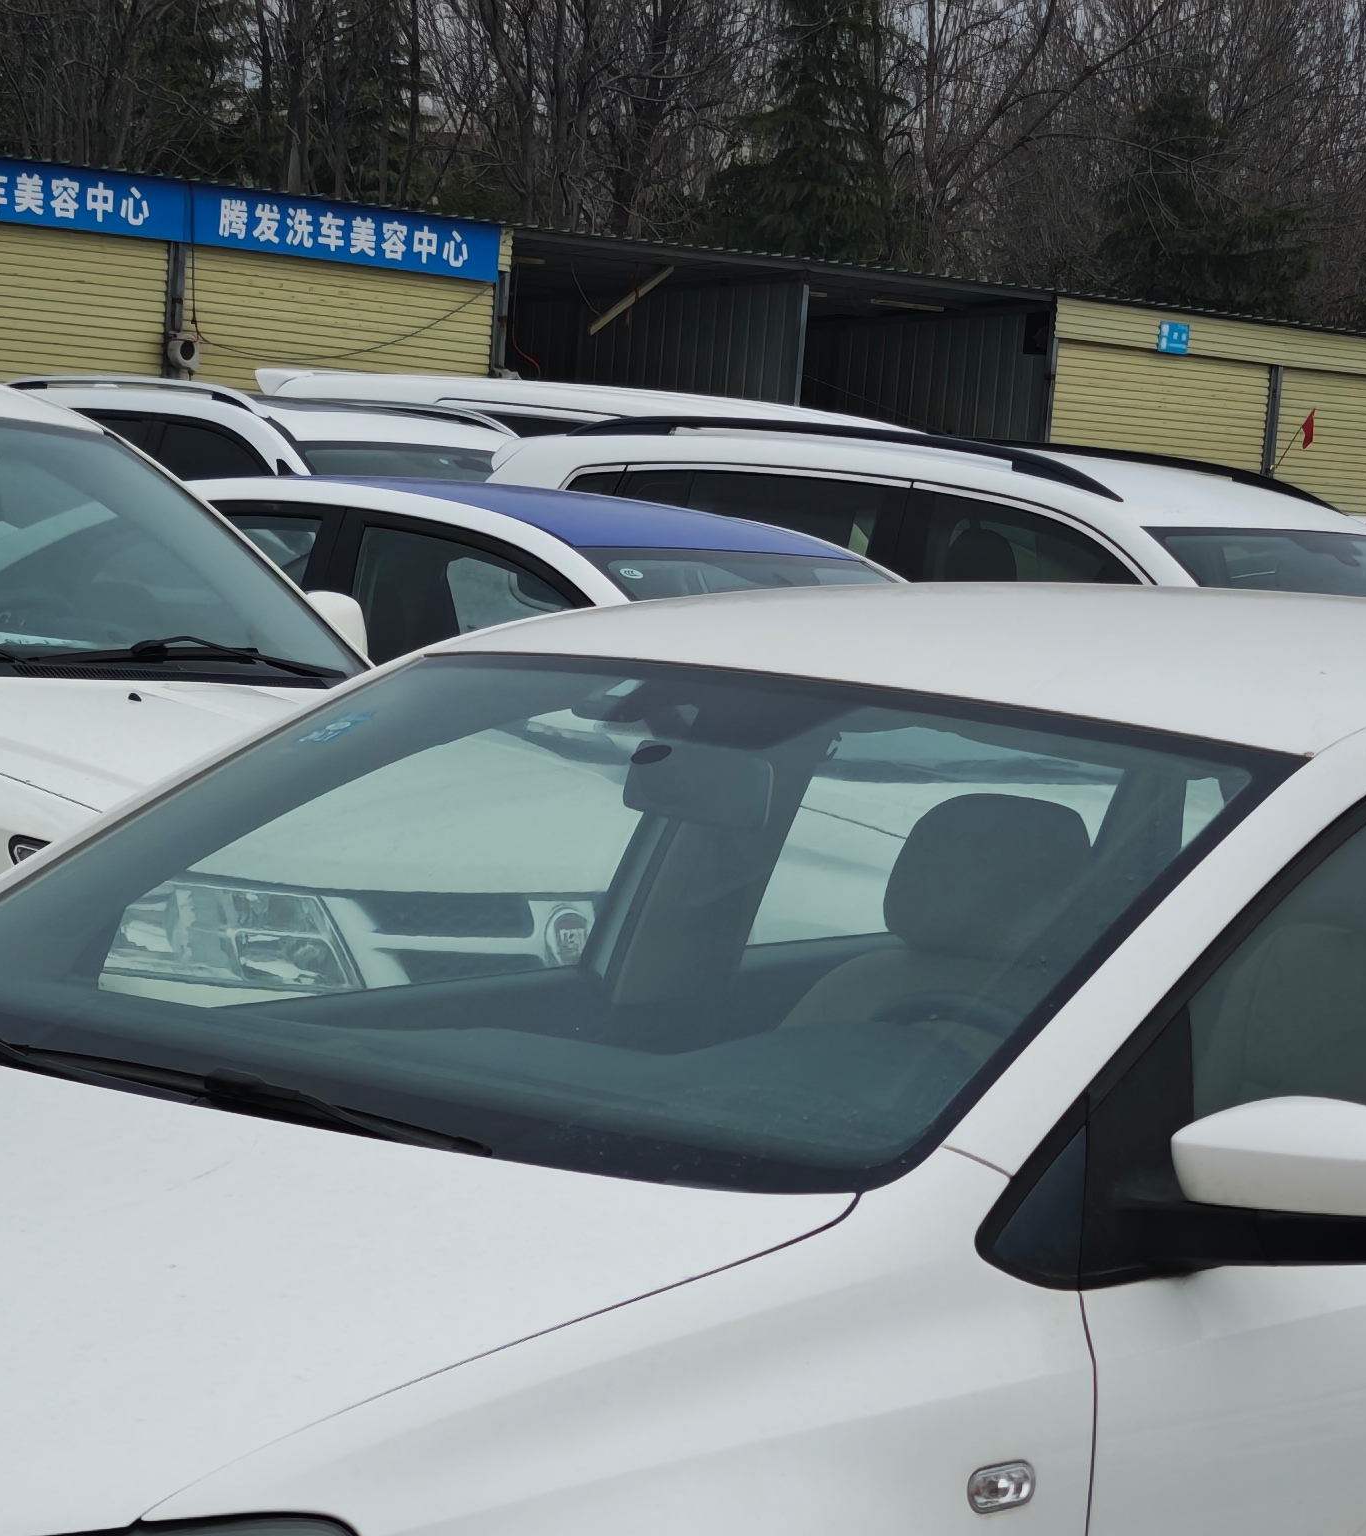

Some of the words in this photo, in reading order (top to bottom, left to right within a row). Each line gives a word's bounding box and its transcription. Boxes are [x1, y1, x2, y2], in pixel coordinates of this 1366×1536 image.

[218, 198, 468, 268] 腾发洗车美容中心
